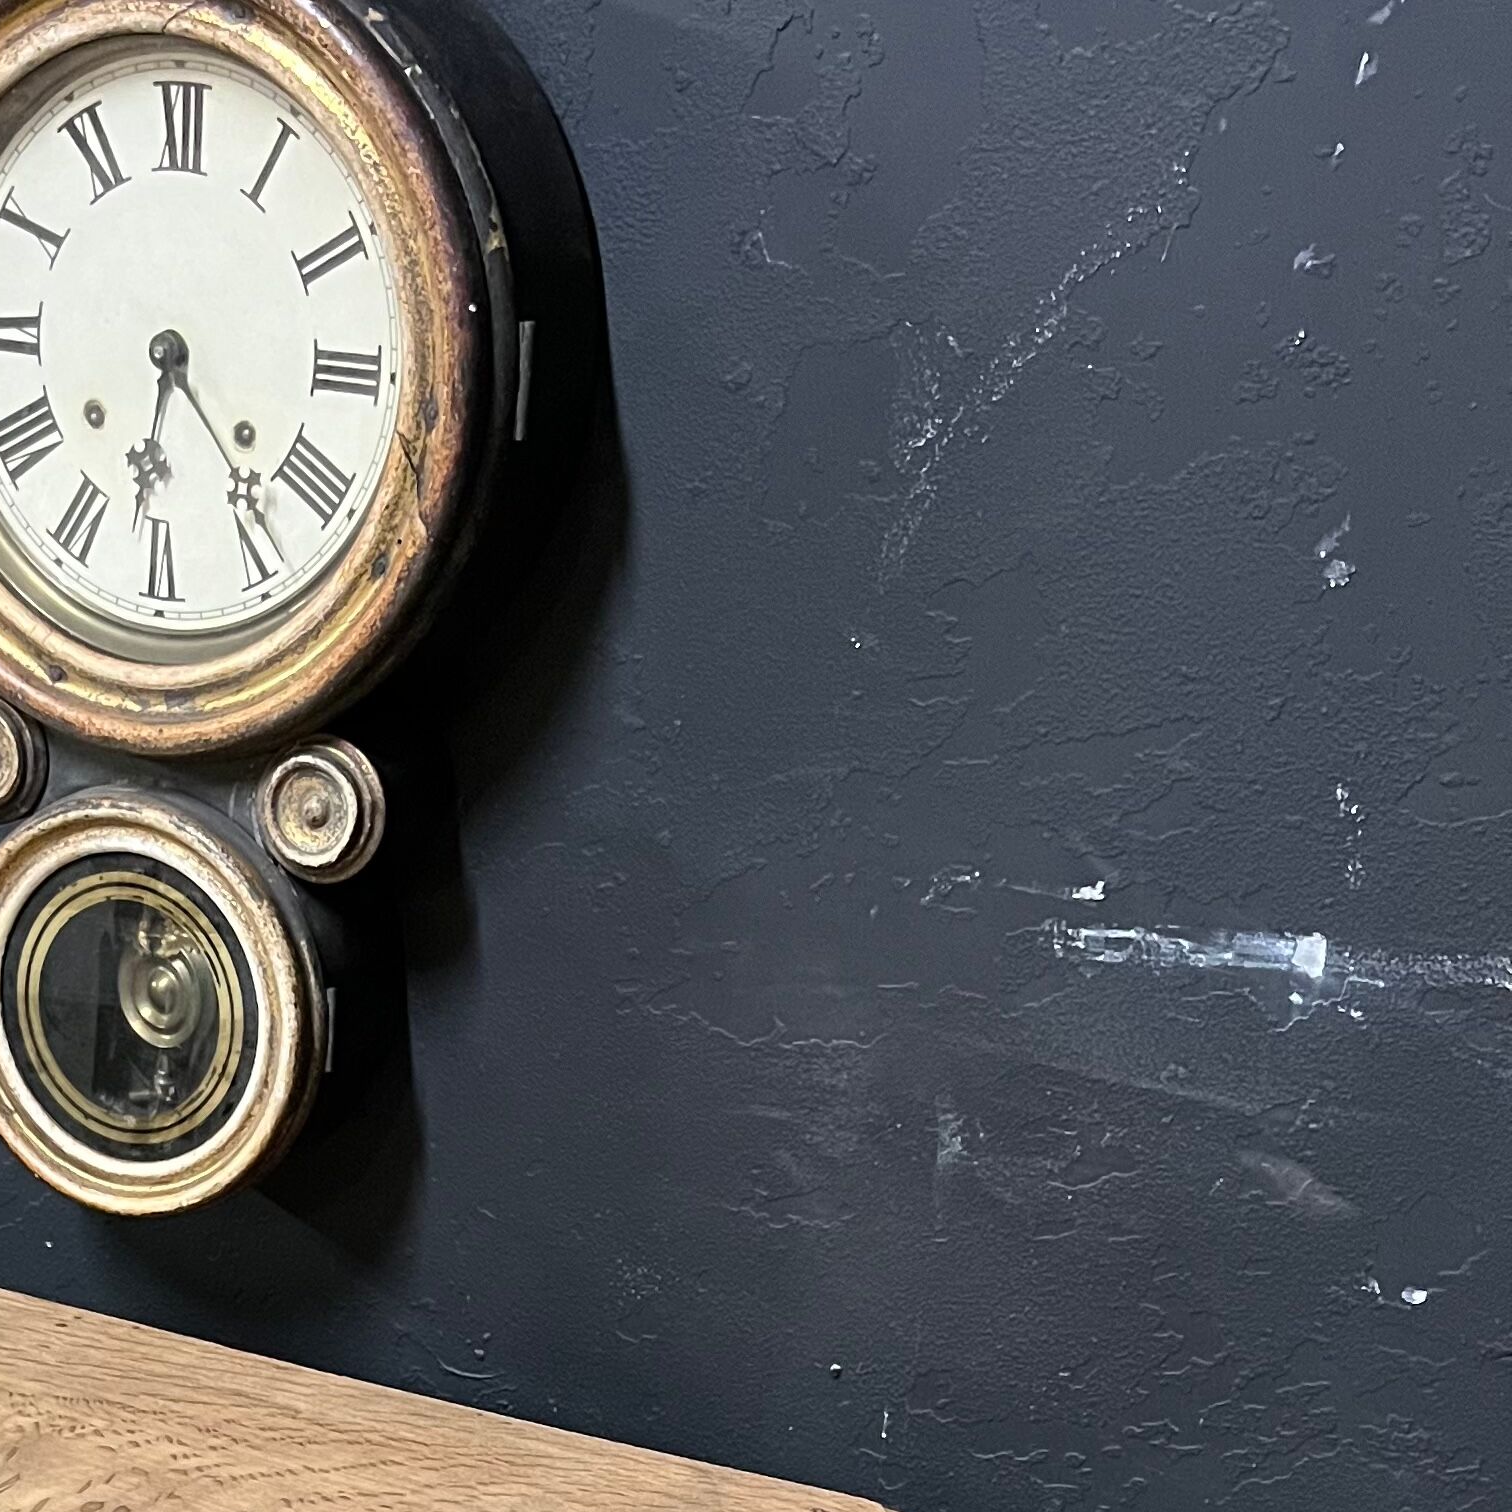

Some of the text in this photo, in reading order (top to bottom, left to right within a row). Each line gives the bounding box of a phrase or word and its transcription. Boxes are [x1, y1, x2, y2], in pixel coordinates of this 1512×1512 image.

[57, 101, 132, 204] XI
[152, 80, 213, 176] XII
[240, 117, 301, 213] I
[291, 211, 369, 296] II
[311, 339, 382, 407] III
[46, 470, 110, 569] VII
[271, 423, 357, 530] IIII
[138, 516, 187, 602] VI
